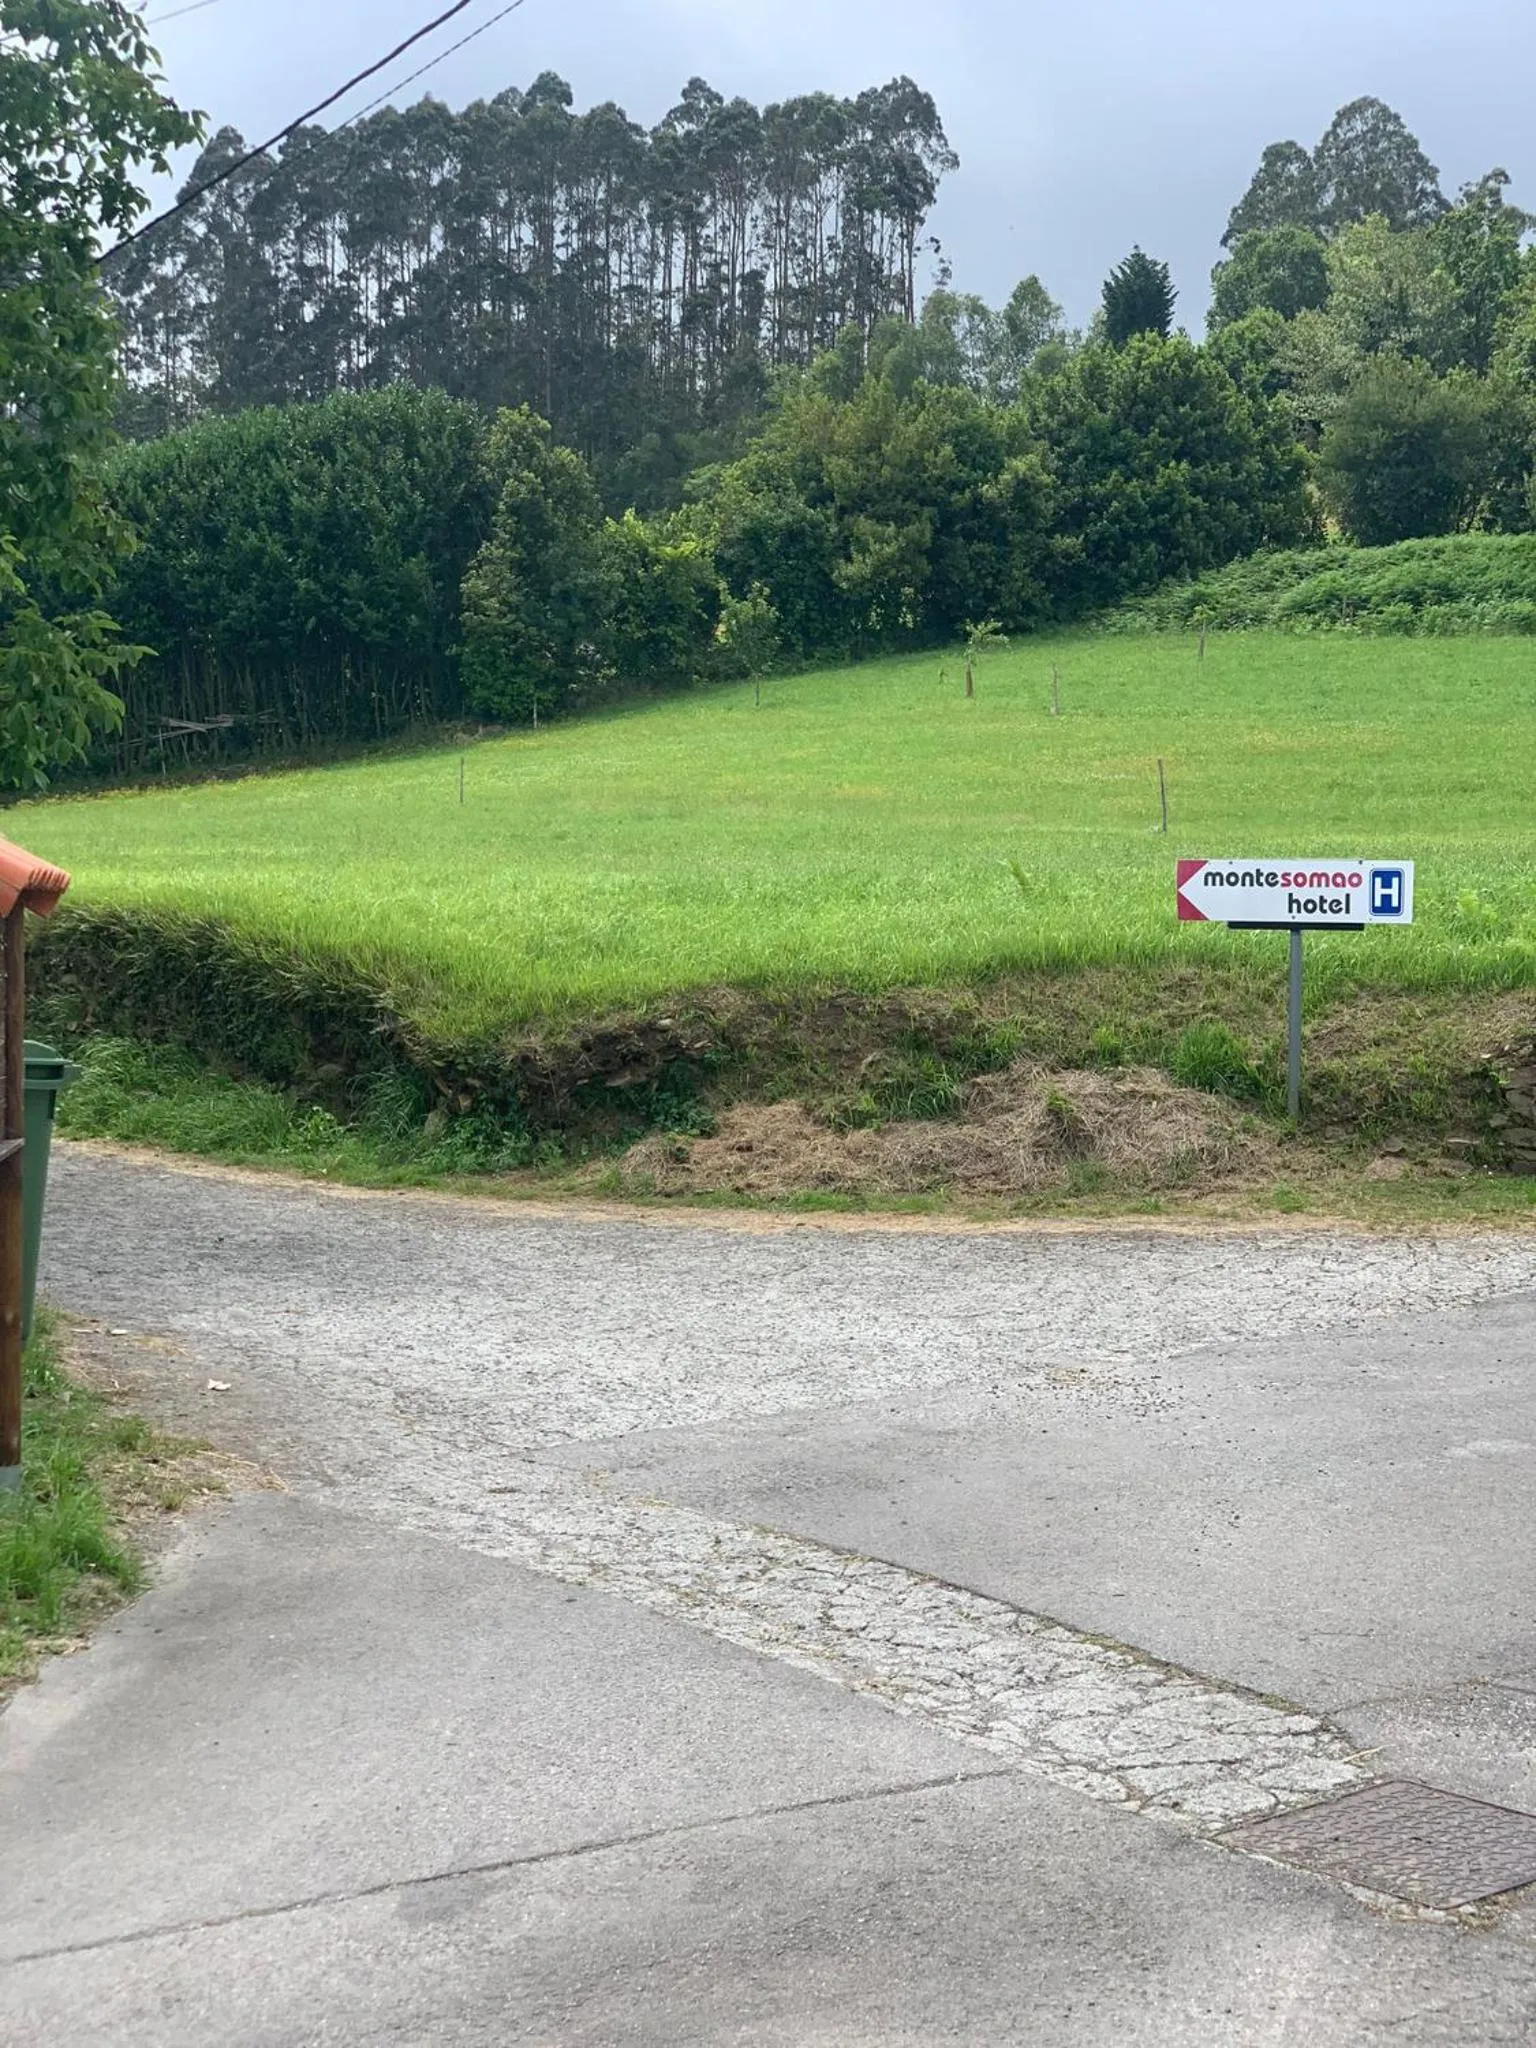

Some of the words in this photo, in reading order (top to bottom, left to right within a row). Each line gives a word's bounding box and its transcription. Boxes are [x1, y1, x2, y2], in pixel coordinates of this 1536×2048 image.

[1203, 868, 1363, 888] montesomao
[1288, 892, 1351, 914] hotel
[1374, 876, 1399, 908] H
